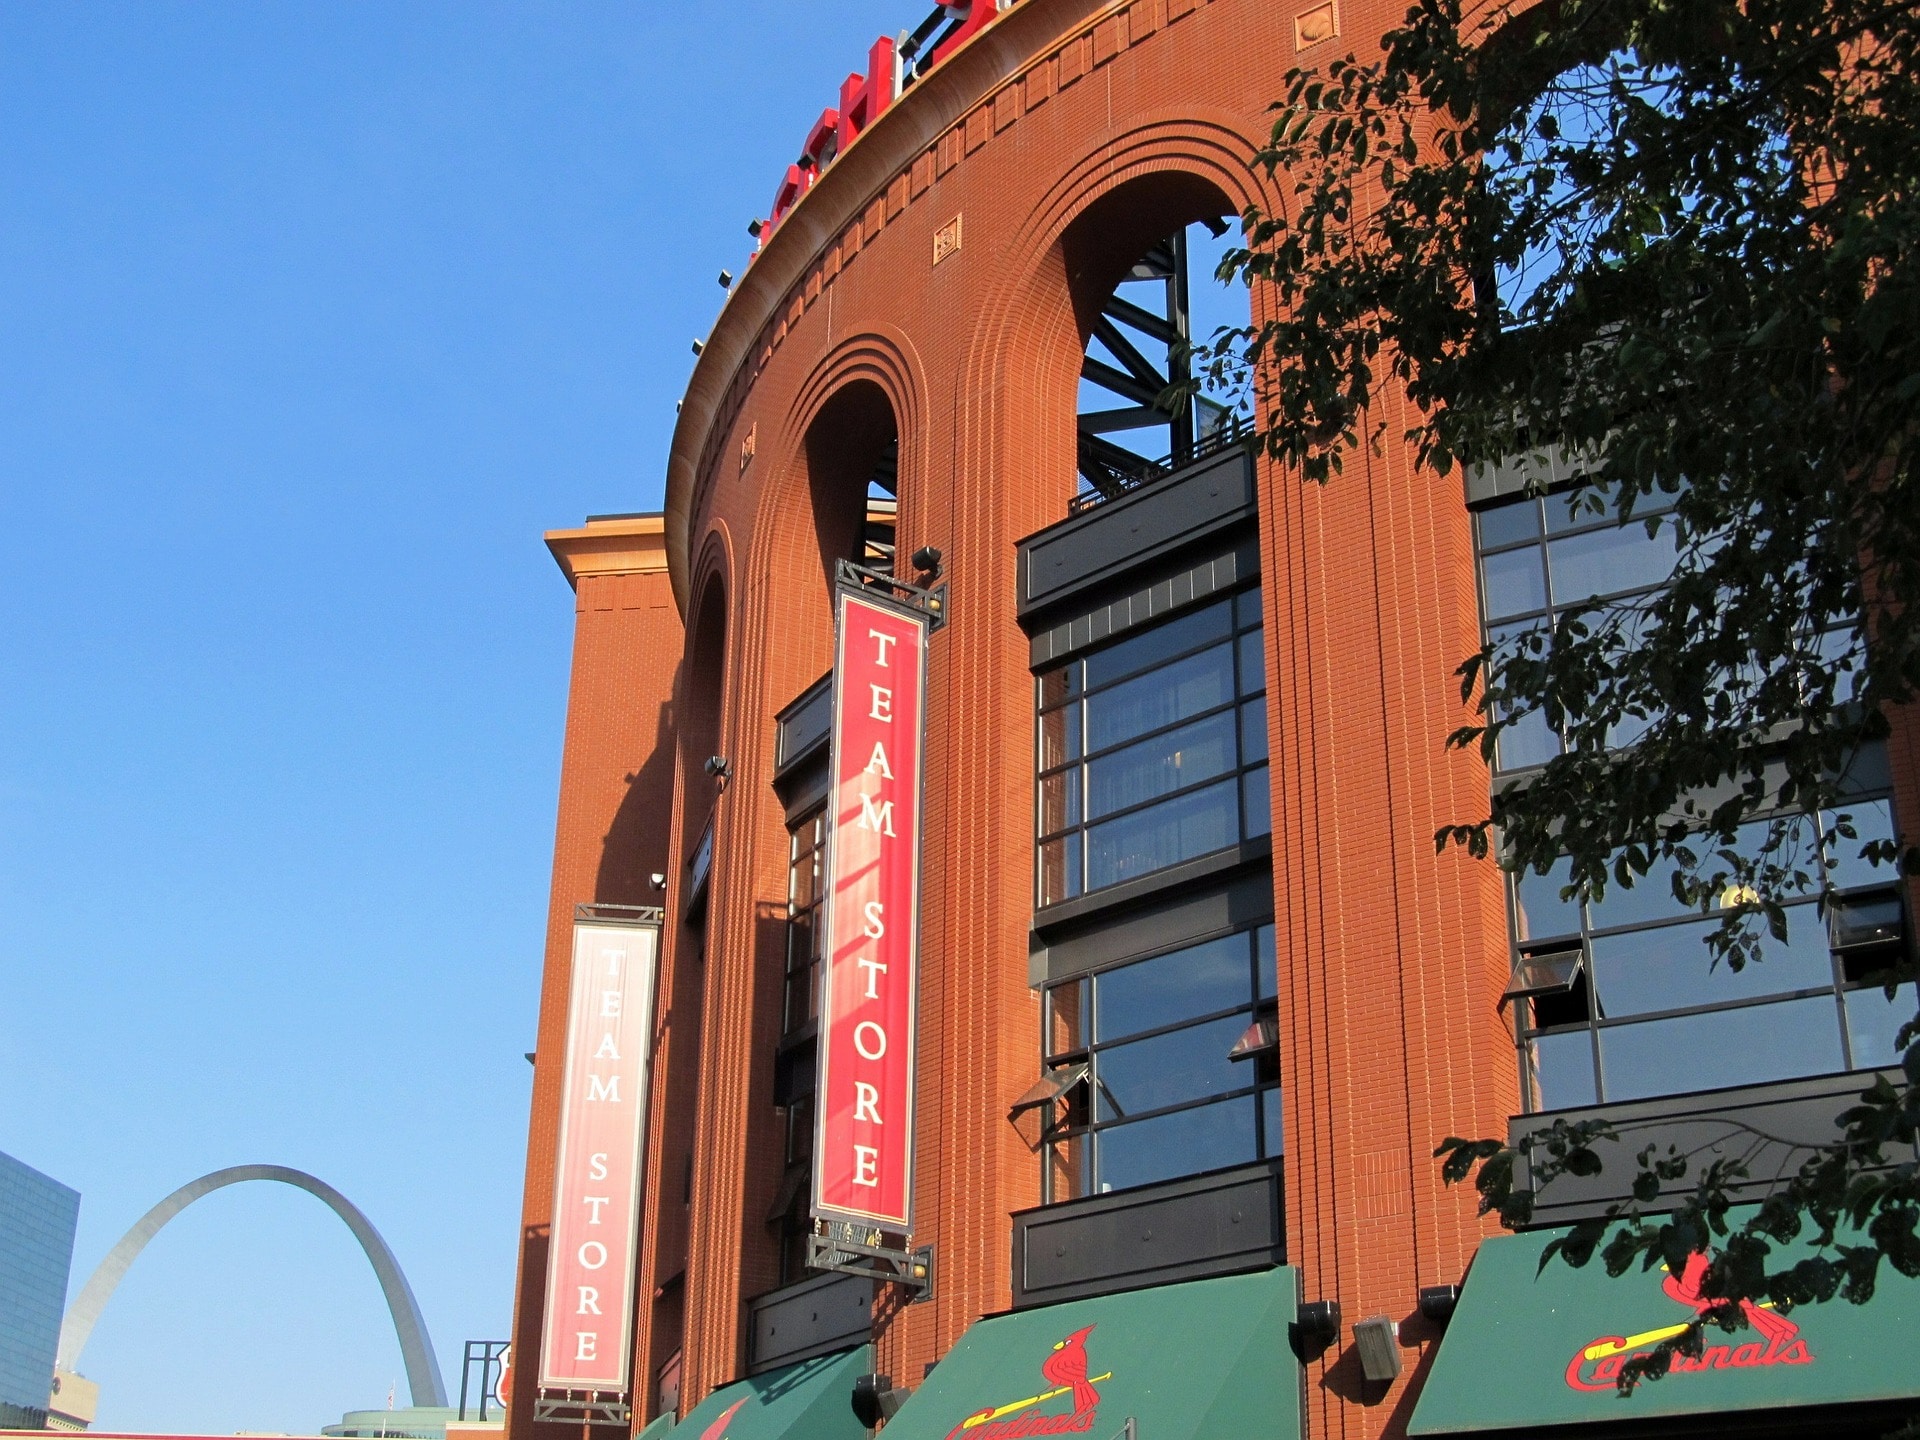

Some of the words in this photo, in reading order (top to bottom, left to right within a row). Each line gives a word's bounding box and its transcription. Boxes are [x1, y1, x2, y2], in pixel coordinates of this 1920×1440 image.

[857, 628, 896, 838] TEAM
[587, 949, 627, 1102] TEAM
[852, 901, 887, 1187] STORE
[575, 1152, 609, 1361] STORE
